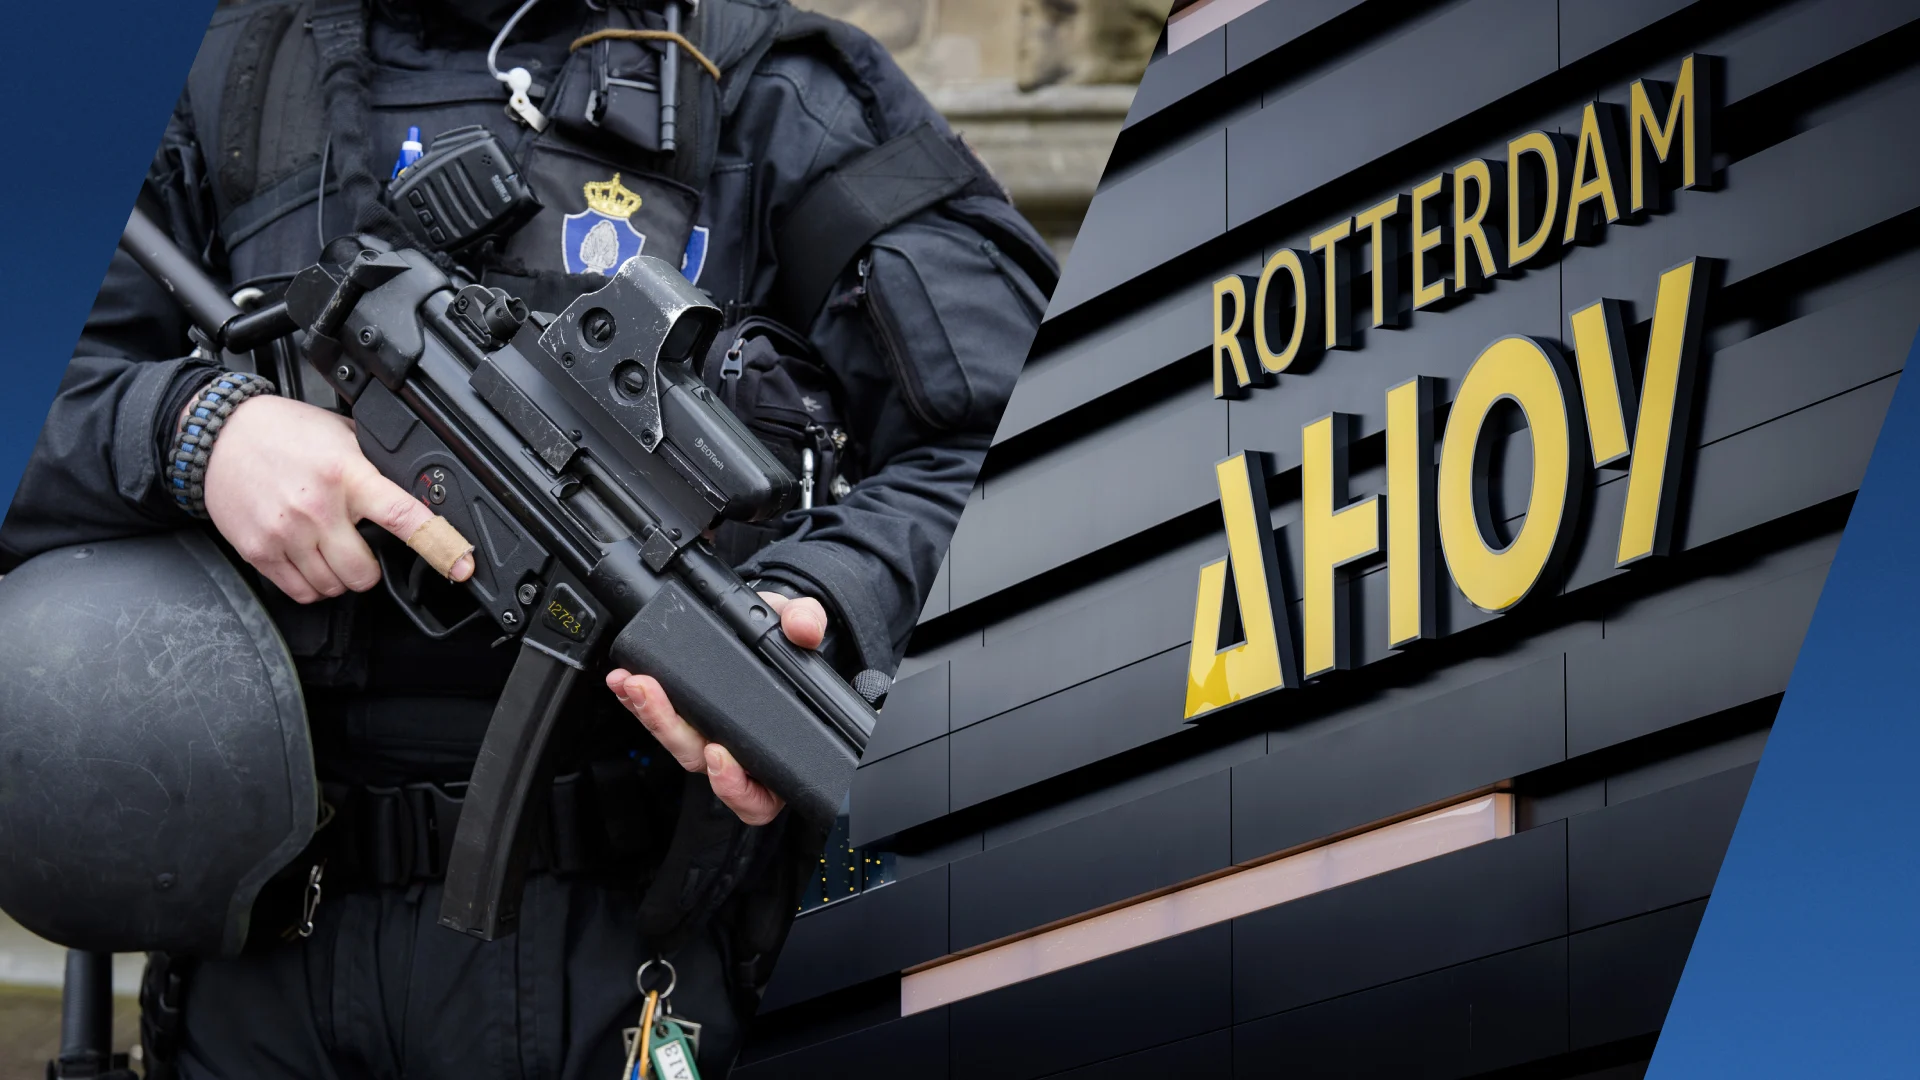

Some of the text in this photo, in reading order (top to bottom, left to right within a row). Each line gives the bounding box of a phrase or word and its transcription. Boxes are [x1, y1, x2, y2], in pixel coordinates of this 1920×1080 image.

[1212, 52, 1698, 398] ROTTERDAM
[700, 444, 724, 470] EOTech
[420, 473, 433, 489] E
[433, 469, 445, 482] S
[1184, 256, 1699, 723] AHOY
[547, 600, 581, 634] 12723
